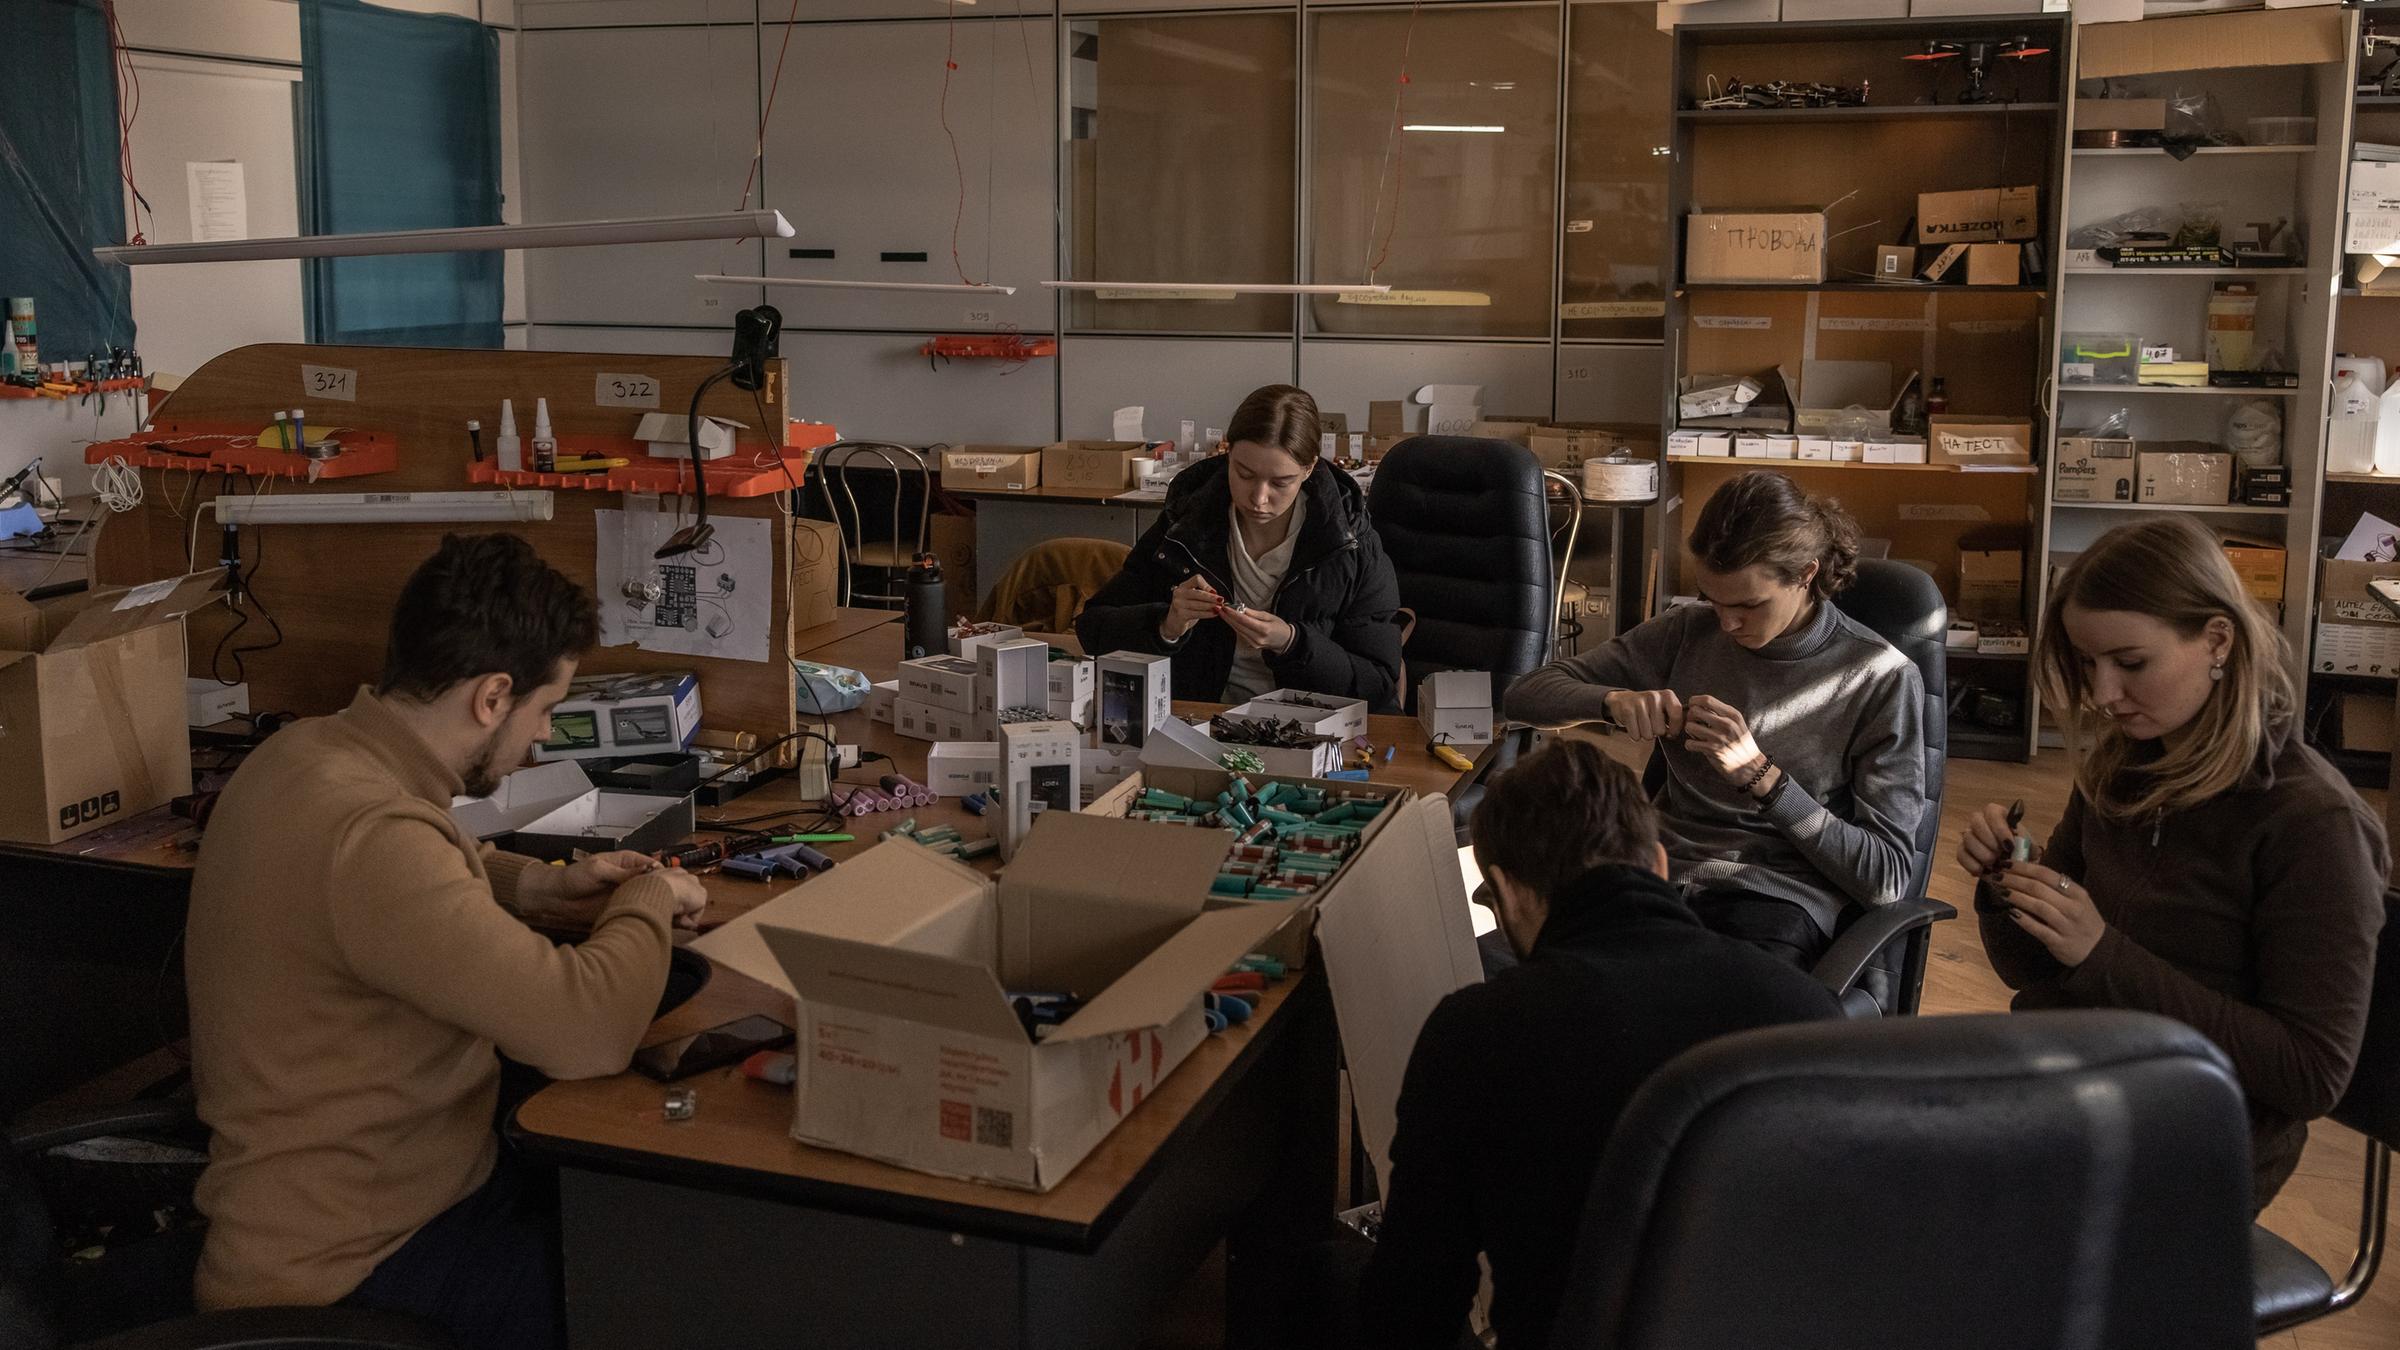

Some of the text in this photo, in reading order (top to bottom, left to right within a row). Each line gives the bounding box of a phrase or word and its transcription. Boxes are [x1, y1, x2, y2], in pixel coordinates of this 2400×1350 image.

[1926, 219, 2003, 235] ROZETKA
[970, 311, 990, 322] 309
[314, 371, 347, 392] 321
[1567, 369, 1588, 380] 310
[612, 380, 653, 398] 322
[1435, 419, 1472, 433] 1000
[1943, 438, 2002, 452] НА ТЕСТ
[2059, 462, 2097, 476] Pampers
